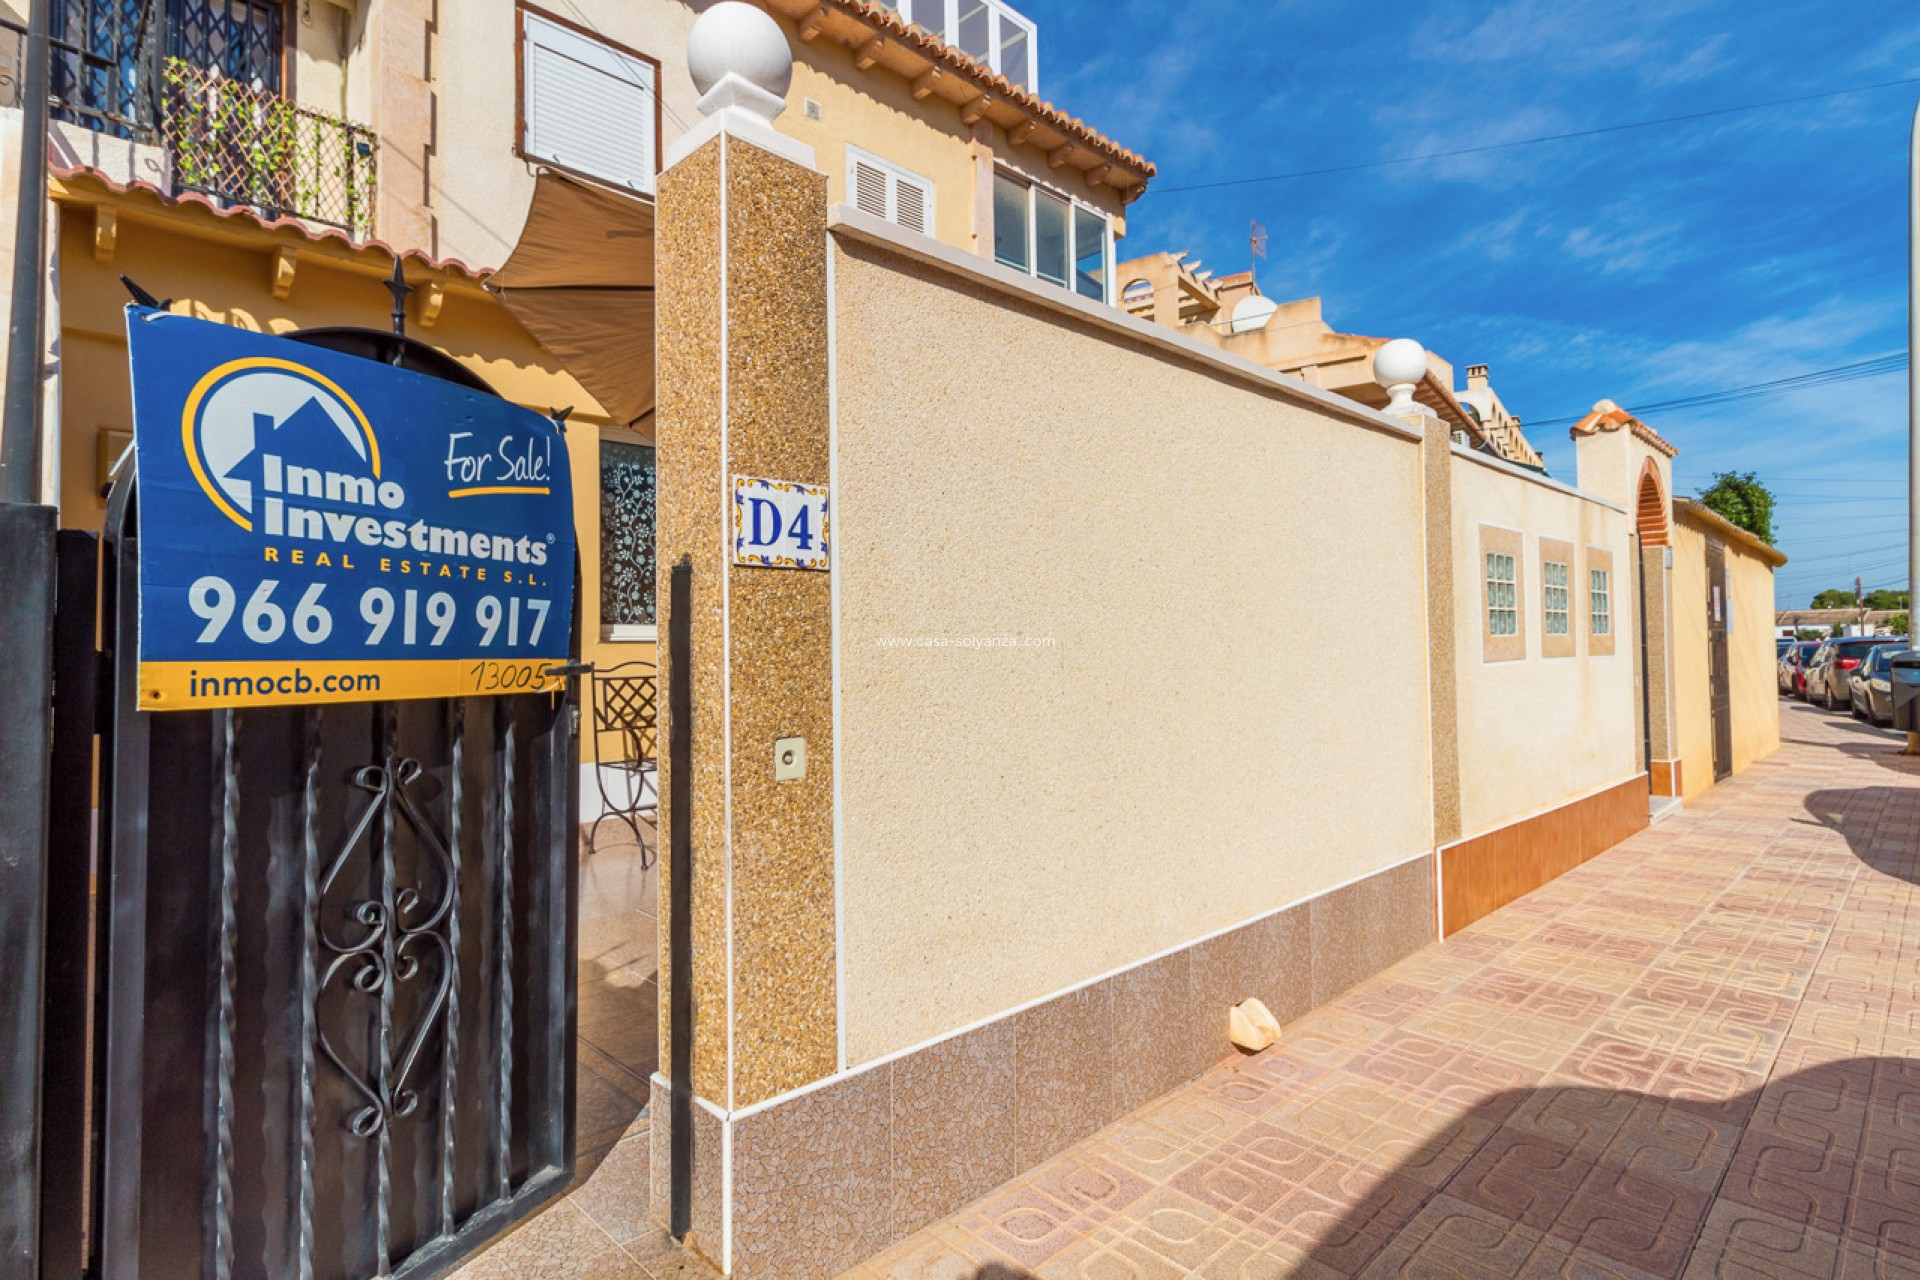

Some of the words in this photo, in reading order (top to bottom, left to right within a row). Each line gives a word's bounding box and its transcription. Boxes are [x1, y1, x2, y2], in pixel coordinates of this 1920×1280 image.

[263, 453, 405, 509] Inmo
[444, 432, 493, 482] For
[496, 435, 551, 481] Sale!
[264, 496, 547, 565] Investments
[748, 497, 813, 550] D4
[264, 547, 355, 569] REAL
[380, 558, 487, 581] ESTATE
[503, 571, 547, 586] S.L.
[188, 575, 333, 645] 966
[359, 587, 457, 646] 919
[475, 594, 551, 647] 917
[190, 669, 381, 697] inmocb.com
[470, 661, 553, 692] 13005
